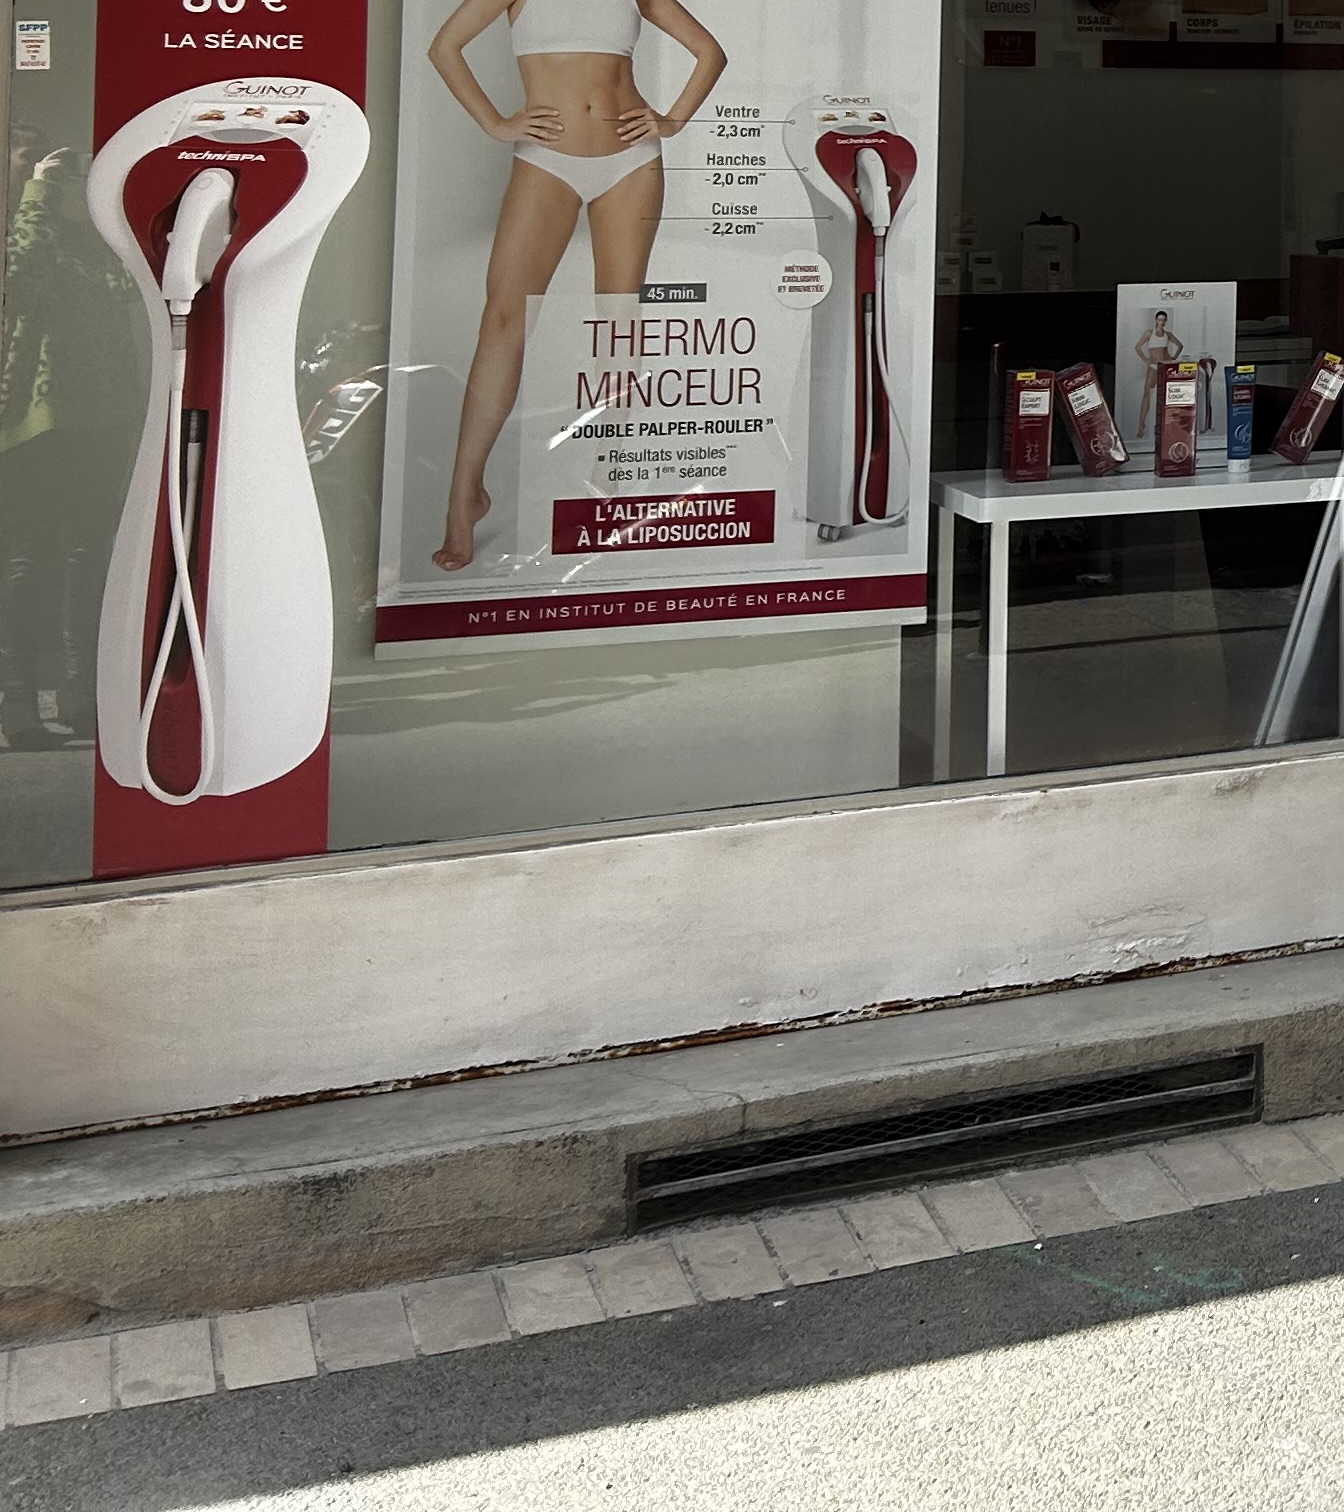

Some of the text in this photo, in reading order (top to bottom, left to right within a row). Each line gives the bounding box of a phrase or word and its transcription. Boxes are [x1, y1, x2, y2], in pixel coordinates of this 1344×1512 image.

[985, 0, 1031, 14] tenues
[164, 29, 304, 50] LA SÉANCE
[223, 81, 311, 96] GUINOT
[715, 105, 760, 119] Ventre
[706, 153, 766, 166] Hanches
[712, 202, 758, 216] Cuisse
[646, 287, 698, 300] 45 min.
[583, 317, 756, 357] THERMO
[576, 367, 761, 409] MINCEUR
[609, 449, 672, 463] Résultats
[608, 467, 633, 482] dès
[637, 466, 649, 480] la
[679, 463, 727, 478] séance
[595, 499, 736, 522] L'ALTERNATIVE
[577, 521, 751, 548] À LA LIPOSUCCION
[468, 589, 846, 624] N°1 EN INSTITUT DE BEAUTÉ EN FRANCE
